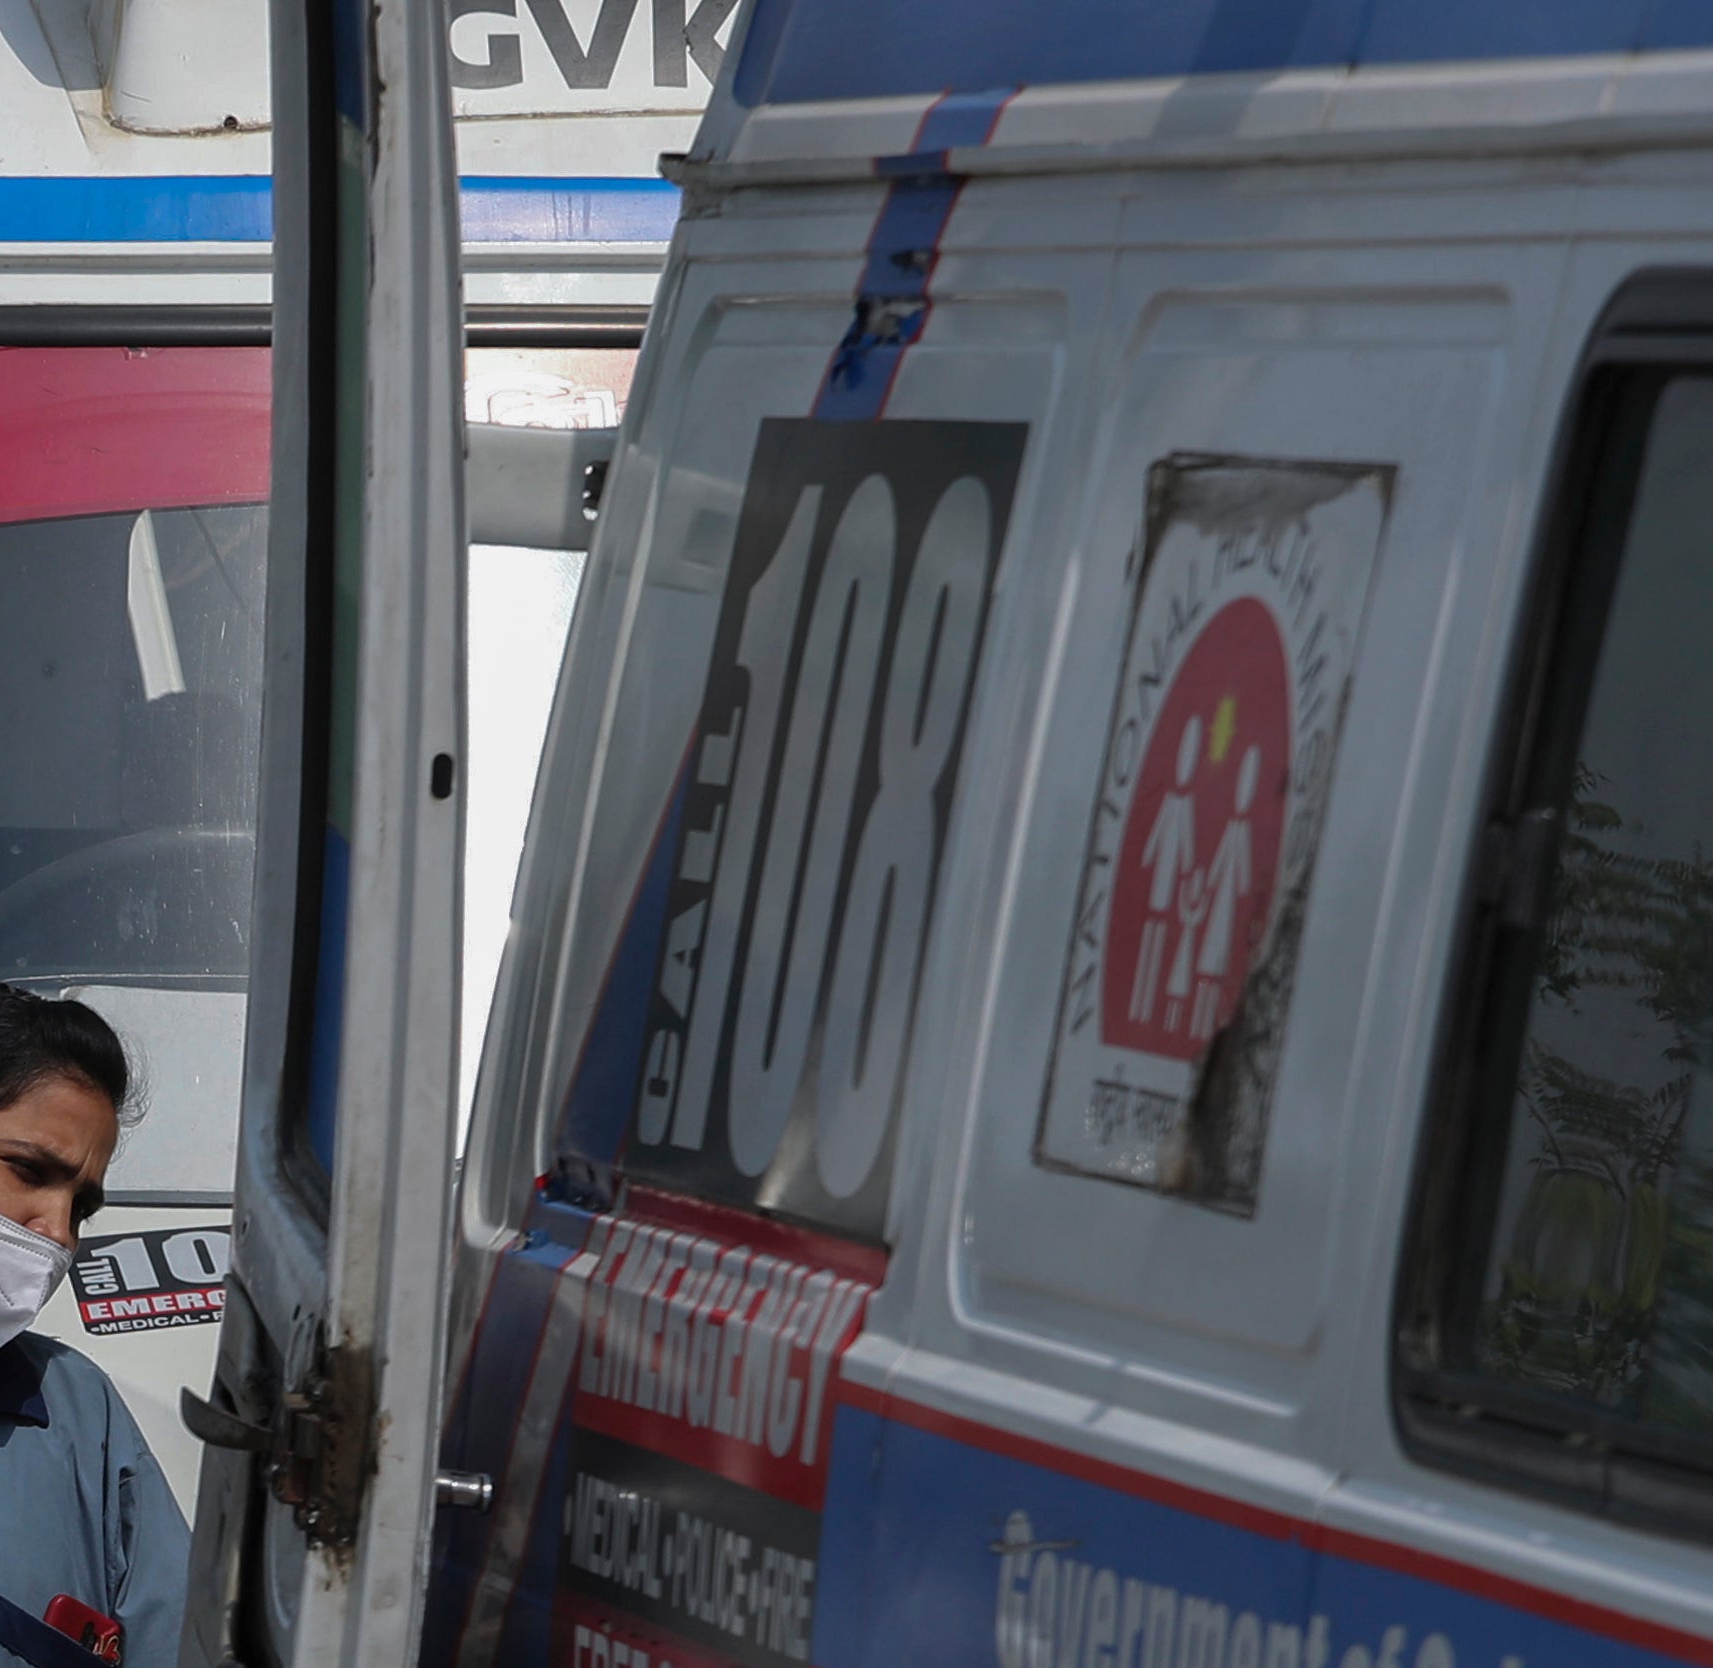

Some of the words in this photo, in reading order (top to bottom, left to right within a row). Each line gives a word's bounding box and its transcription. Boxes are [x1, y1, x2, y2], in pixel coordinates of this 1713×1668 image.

[450, 0, 727, 89] GVK
[670, 473, 993, 1200] 108
[638, 706, 744, 1147] CALL
[77, 1257, 120, 1296] CALL
[86, 1290, 226, 1320] EMERG
[90, 1231, 232, 1292] 10
[100, 1313, 200, 1333] MEDICAL
[577, 1215, 871, 1467] EMERGENCY
[571, 1472, 662, 1600] MEDICAL
